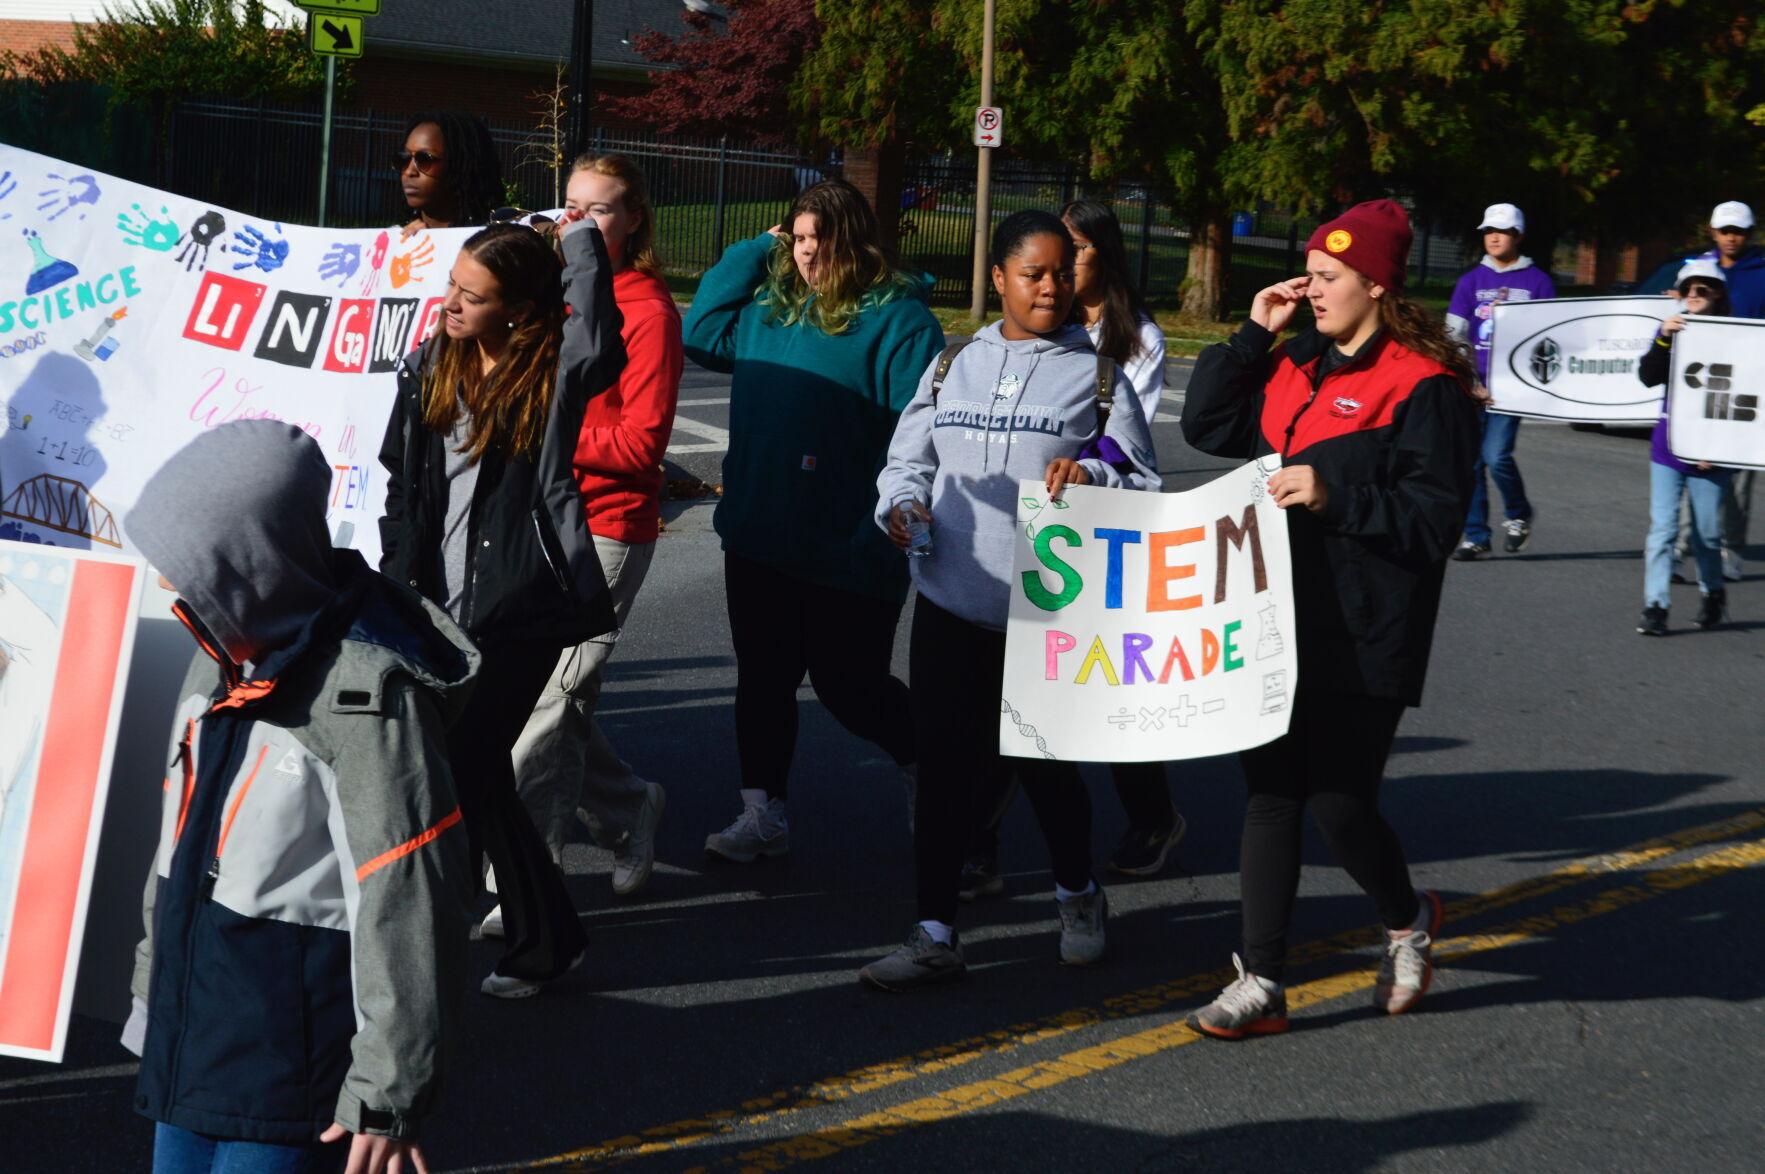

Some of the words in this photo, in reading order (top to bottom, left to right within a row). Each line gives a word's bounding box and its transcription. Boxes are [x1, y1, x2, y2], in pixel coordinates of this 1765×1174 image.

[0, 265, 142, 333] SCIENCE
[1569, 356, 1633, 374] Computer
[189, 367, 321, 438] Won
[934, 400, 1065, 437] GEORGETOWN
[964, 430, 1018, 443] HOYAS
[332, 465, 369, 511] TEM
[1021, 502, 1268, 613] STEM
[1045, 619, 1245, 686] PARADE
